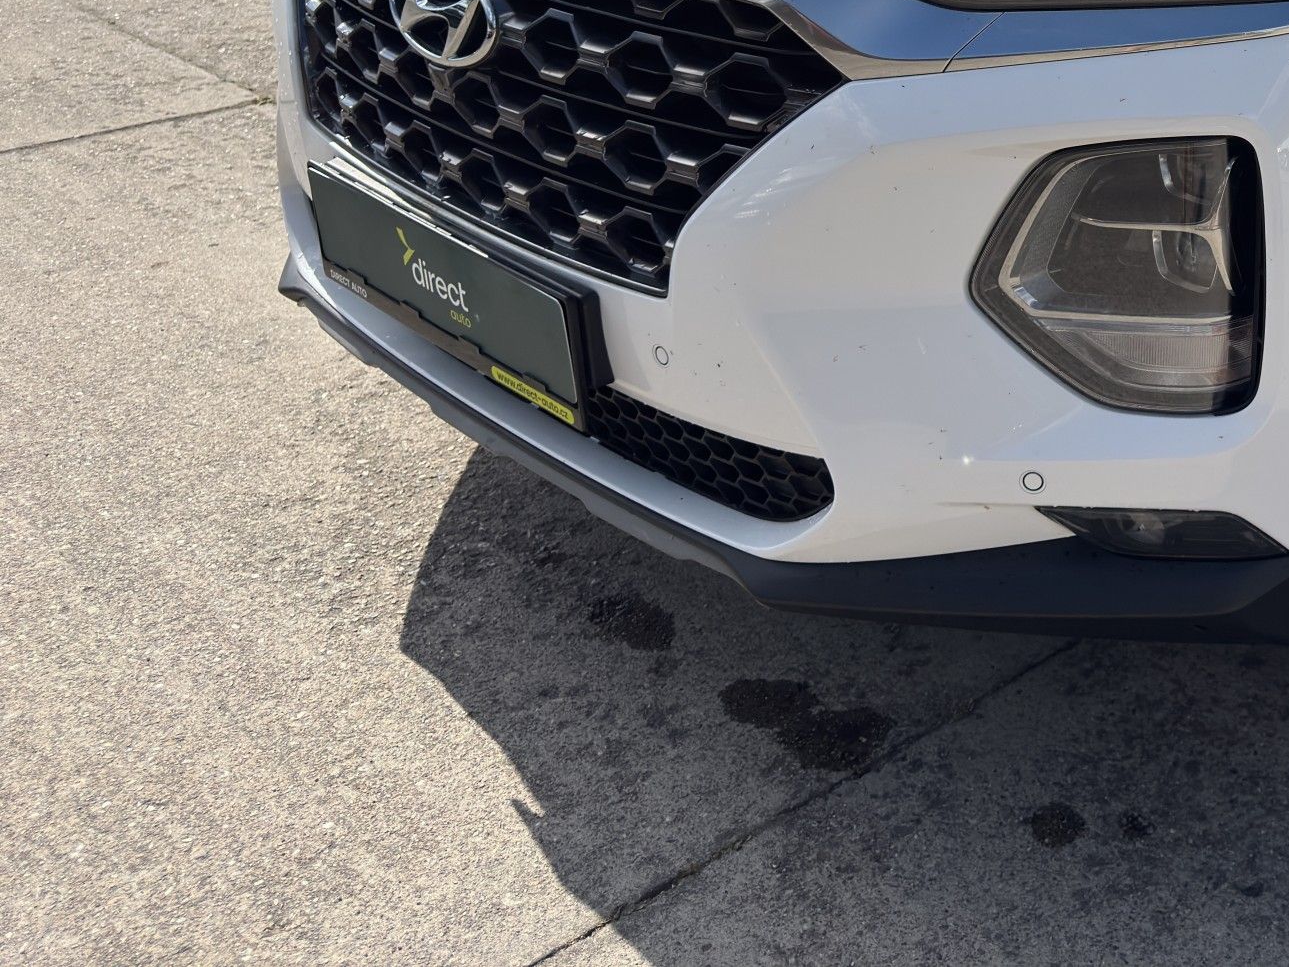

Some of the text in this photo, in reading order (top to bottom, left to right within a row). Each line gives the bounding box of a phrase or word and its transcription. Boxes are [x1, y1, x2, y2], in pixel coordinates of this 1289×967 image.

[330, 269, 368, 299] DIRECT AUTO
[411, 258, 469, 313] direct
[450, 309, 472, 329] auto
[496, 371, 569, 420] www.direct-auto.cz
